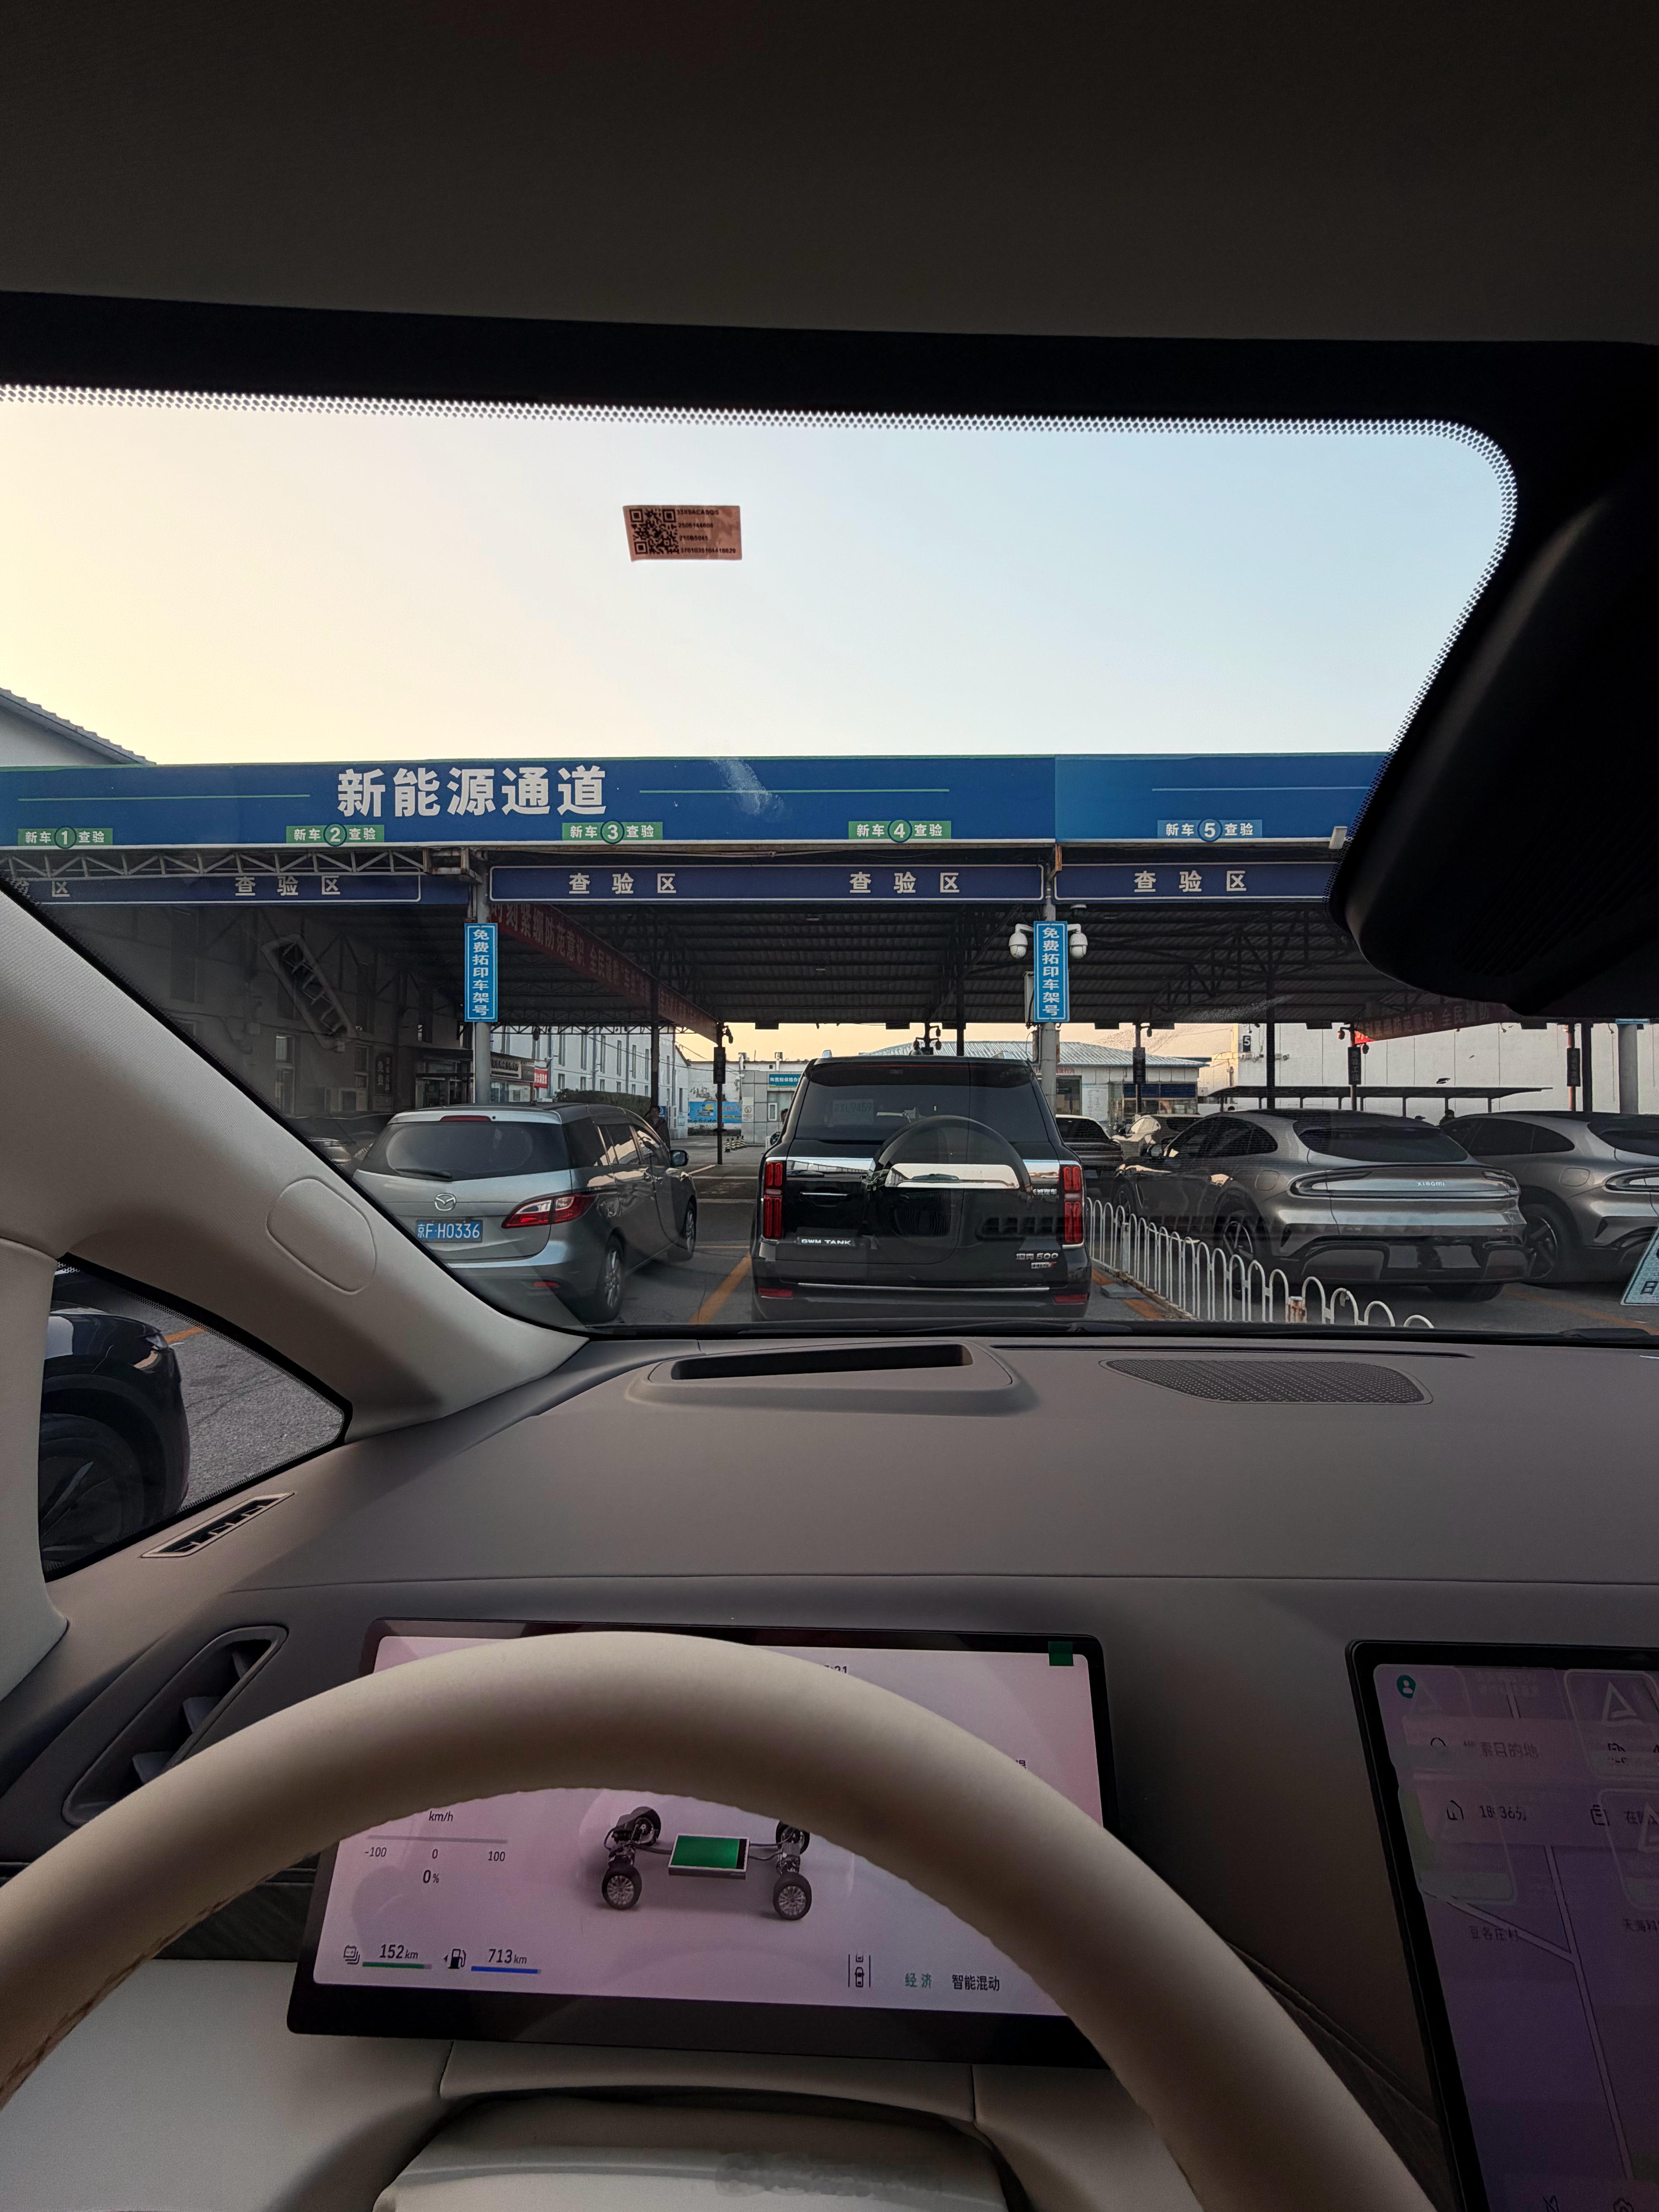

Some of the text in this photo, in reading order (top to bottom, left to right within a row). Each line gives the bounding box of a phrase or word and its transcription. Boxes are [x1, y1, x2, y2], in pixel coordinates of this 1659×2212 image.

[337, 765, 606, 818] 新能源通道
[235, 875, 340, 896] 查验区
[568, 873, 677, 895] 查验区
[849, 871, 960, 894] 查验区
[1133, 870, 1248, 893] 查验区
[472, 929, 490, 1016] 免费拓印车架号
[1042, 926, 1060, 1017] 免费拓印车架号
[1243, 1036, 1250, 1046] 5
[429, 1811, 453, 1822] km/h
[364, 1847, 505, 1862] -100 0 100
[905, 1972, 1000, 1992] 经济 智能混动
